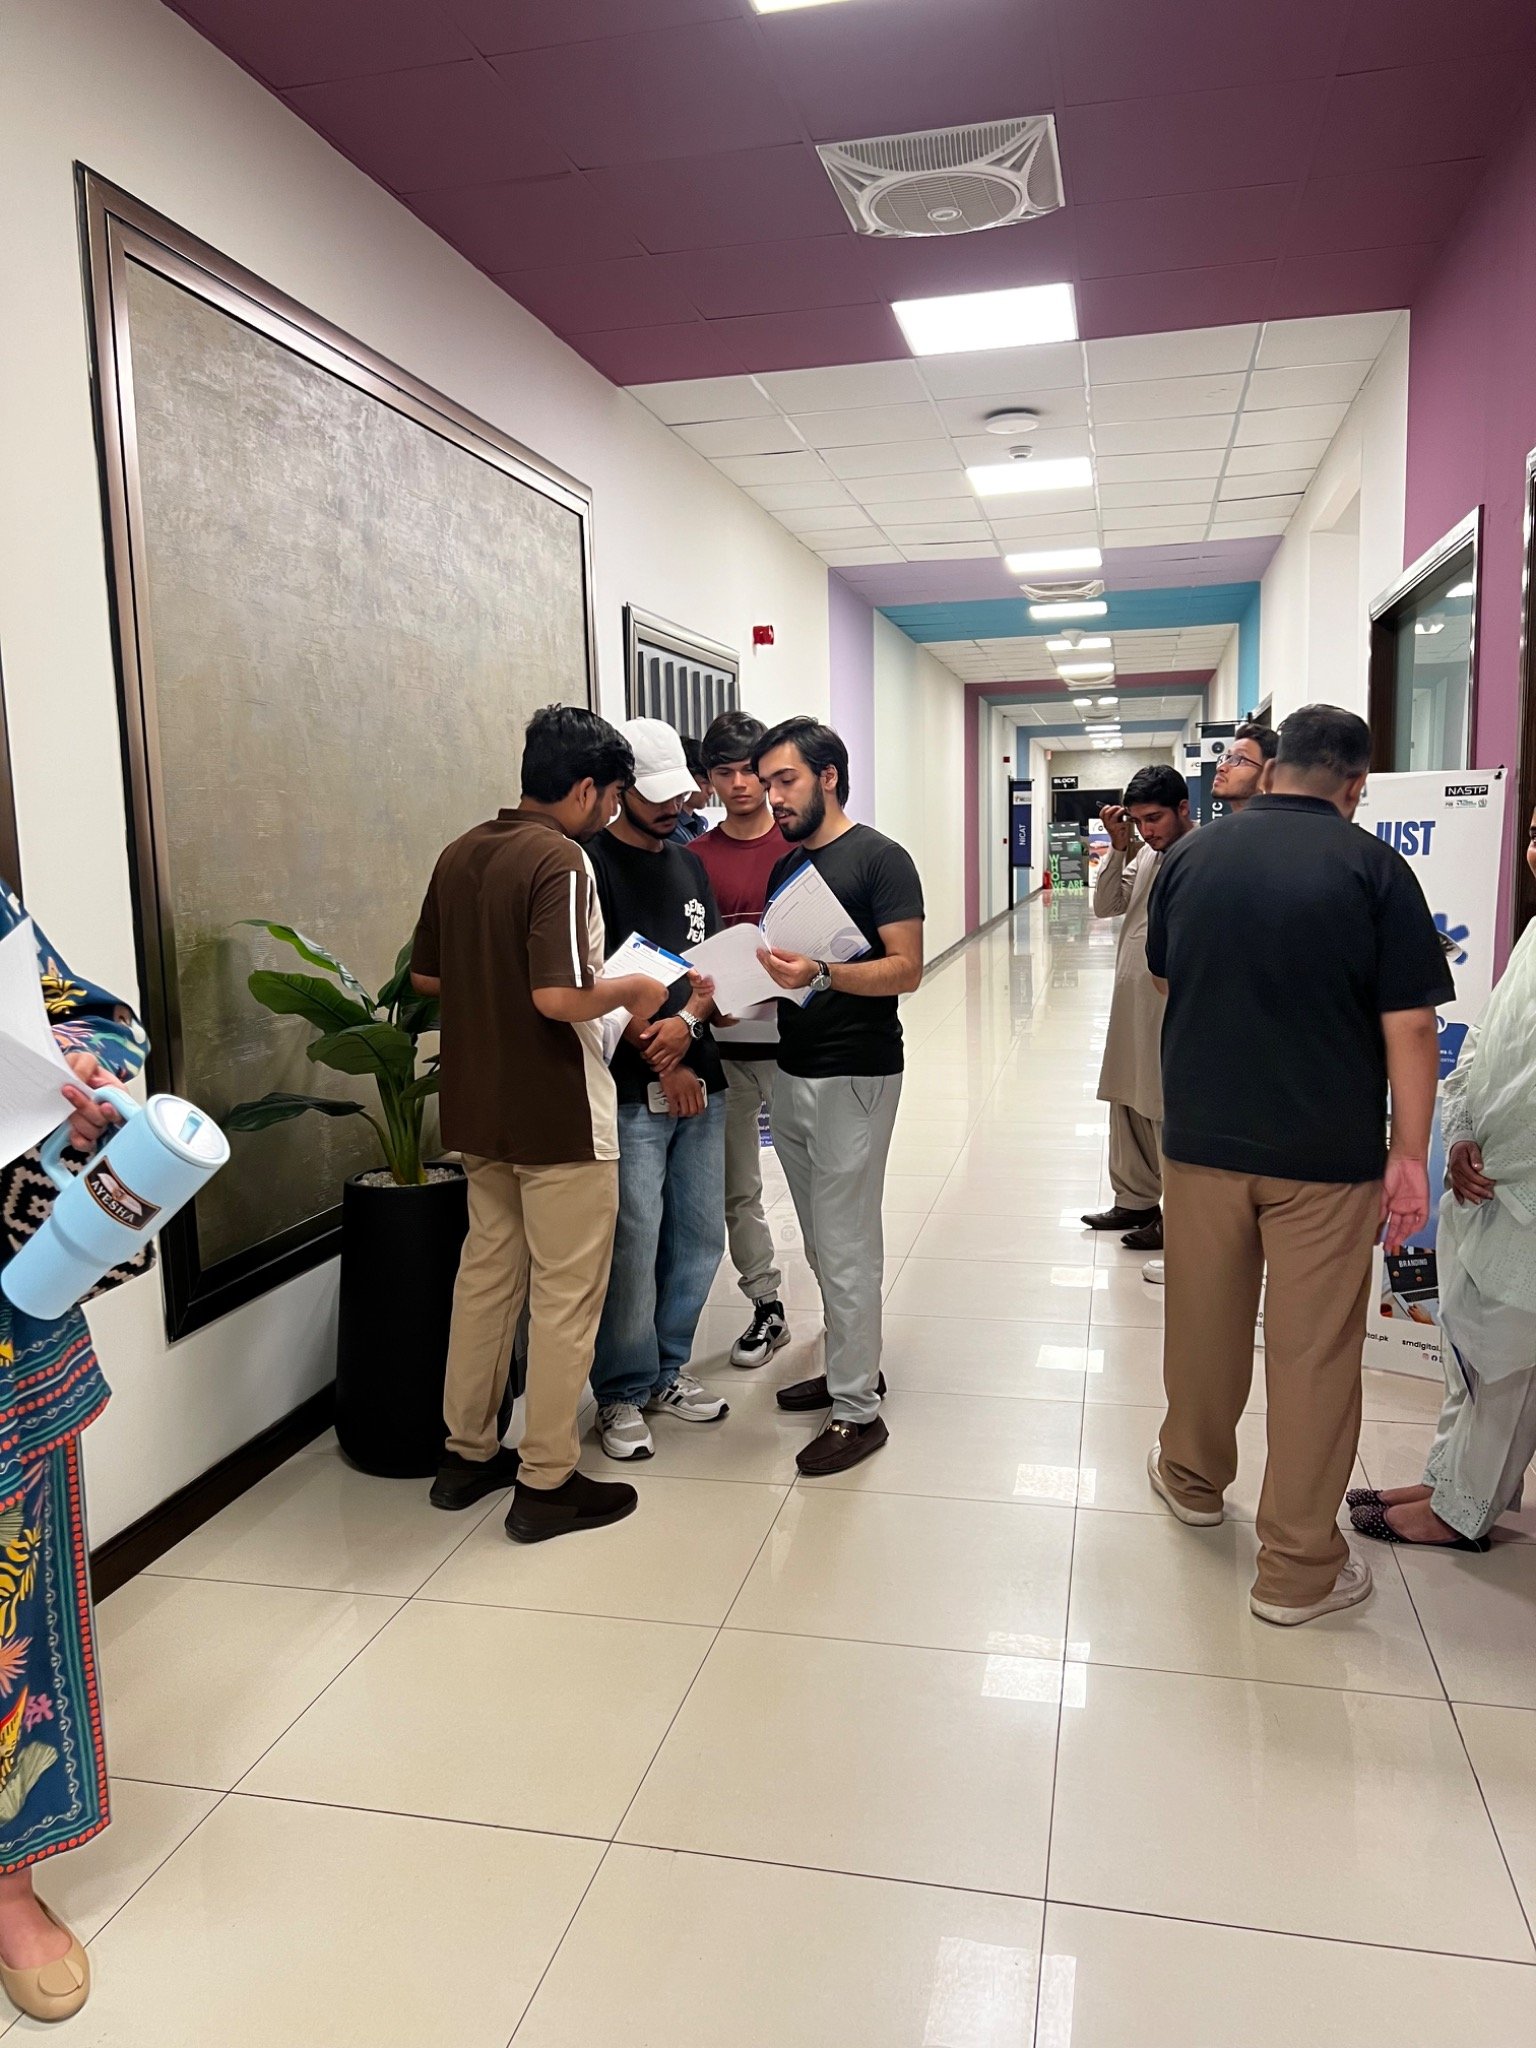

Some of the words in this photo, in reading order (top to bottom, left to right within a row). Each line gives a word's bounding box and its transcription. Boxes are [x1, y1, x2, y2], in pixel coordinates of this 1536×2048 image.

[1447, 786, 1488, 796] NASTP
[1018, 823, 1027, 846] NICAT
[1048, 854, 1060, 881] WHO
[1067, 879, 1084, 889] ARE
[91, 1180, 135, 1222] AYESHA
[1366, 1332, 1389, 1342] tal.pk
